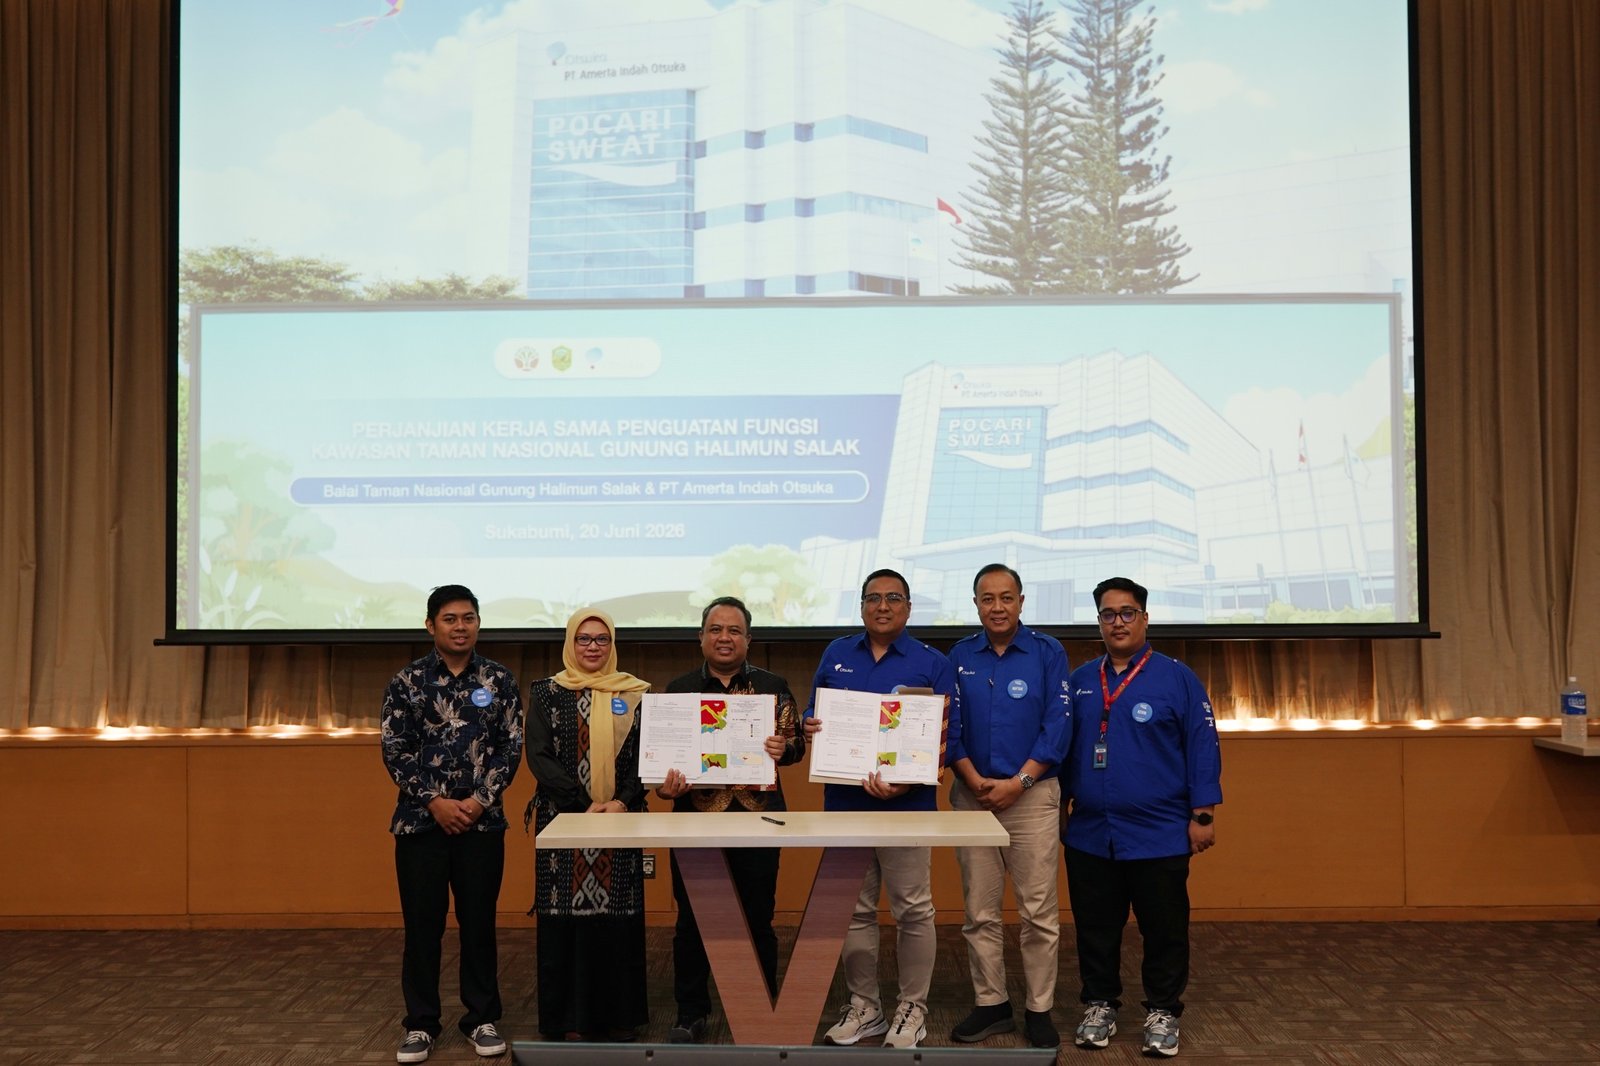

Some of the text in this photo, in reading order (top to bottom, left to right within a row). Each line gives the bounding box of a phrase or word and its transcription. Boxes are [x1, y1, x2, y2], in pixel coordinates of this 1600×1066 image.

[564, 62, 686, 81] PT Amerta Indah Otsuka
[547, 109, 671, 138] POCARI
[548, 132, 662, 161] SWEAT
[352, 418, 818, 438] PERJANJIAN KERJA SAMA PENGUATAN FUNGSI
[949, 417, 1032, 433] POCARI
[311, 439, 860, 460] KAWASAN TAMAN NASIONAL GUNUNG HALIMUN SALAK
[947, 432, 1024, 448] SWEAT
[323, 480, 834, 499] Balai Taman Nasional Gunung Halimun Salak & PT Amerta Indah Otsuka
[484, 523, 685, 541] Sukabumi, 20 Juni 2026
